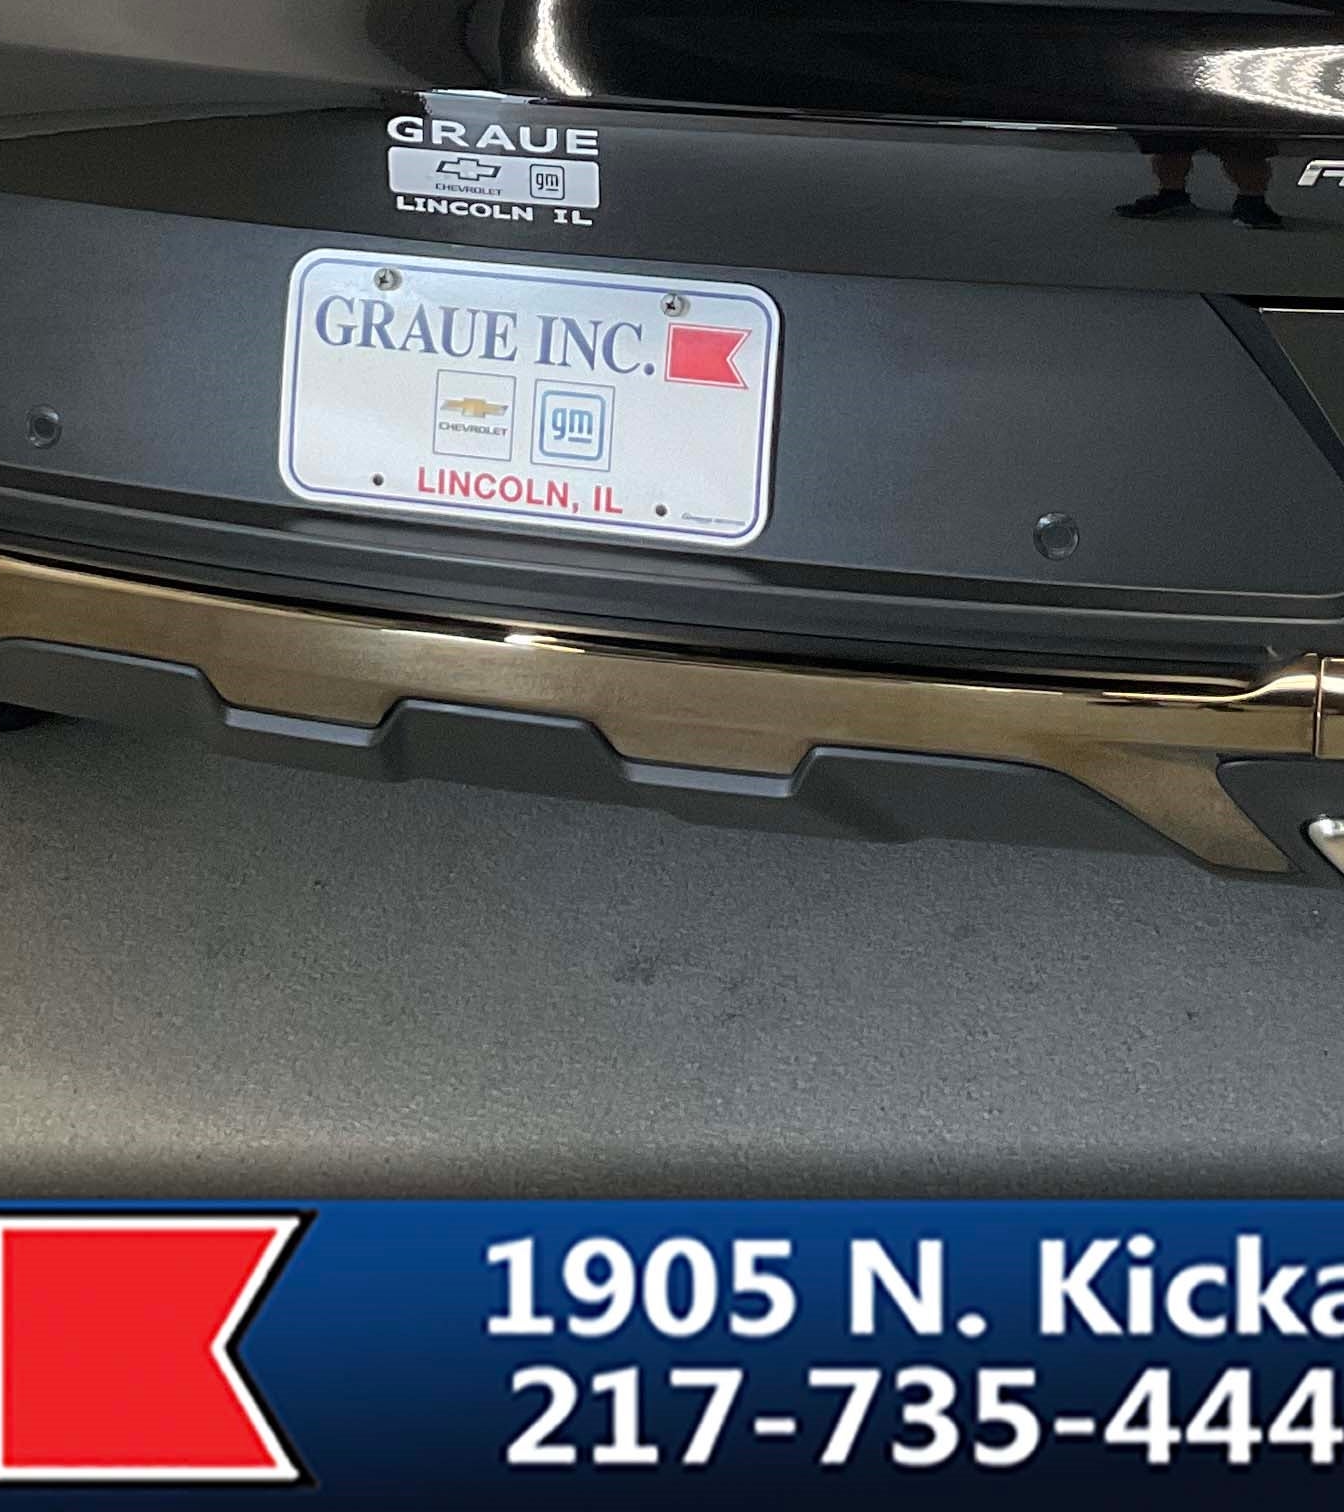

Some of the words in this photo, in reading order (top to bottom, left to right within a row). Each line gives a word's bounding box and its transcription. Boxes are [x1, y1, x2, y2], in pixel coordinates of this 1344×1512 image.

[387, 116, 598, 156] GRAUE
[435, 182, 503, 197] CHEVROLET
[535, 172, 559, 192] gm
[396, 195, 534, 221] LINCOLN
[554, 208, 593, 226] IL
[315, 294, 518, 362] GRAUE
[534, 313, 656, 376] INC.
[438, 421, 508, 437] CHEVROLET
[551, 405, 594, 443] gm
[417, 466, 580, 514] LINCOLN,
[593, 486, 624, 515] IL
